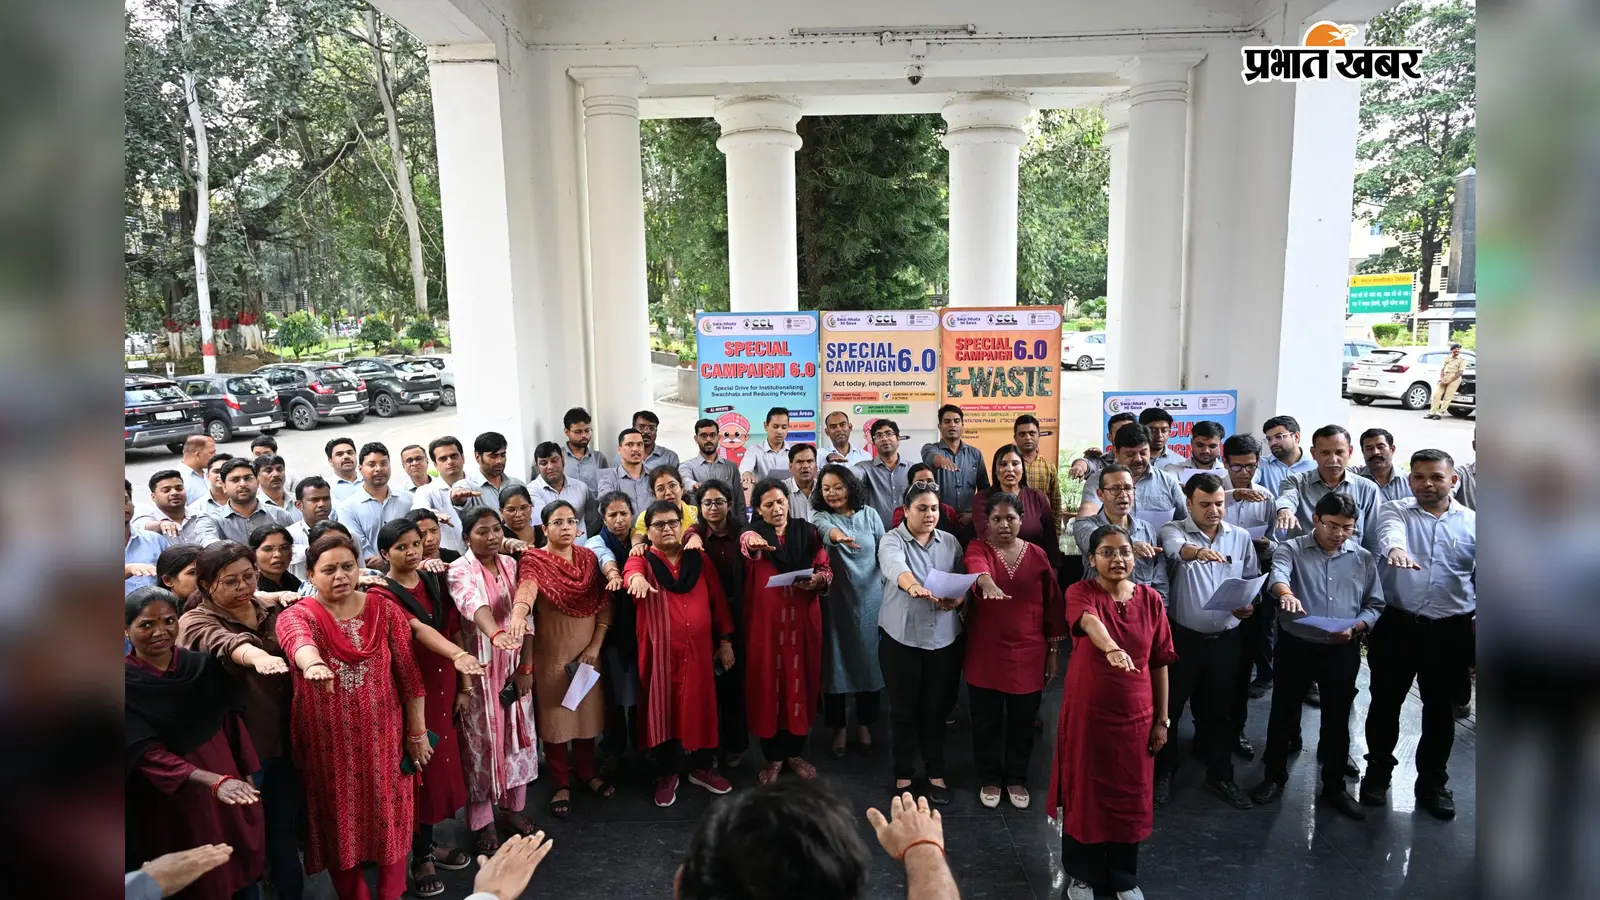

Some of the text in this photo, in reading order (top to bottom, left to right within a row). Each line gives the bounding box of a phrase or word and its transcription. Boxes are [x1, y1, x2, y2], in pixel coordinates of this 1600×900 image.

[752, 319, 774, 327] CCL
[996, 314, 1017, 322] CCL
[724, 341, 792, 357] SPECIAL
[826, 342, 896, 359] SPECIAL
[955, 338, 1012, 350] SPECIAL
[955, 340, 1047, 361] CAMPAIGN 6.0
[826, 348, 936, 373] CAMPAIGN 6.0
[700, 362, 816, 379] CAMPAIGN 6.0
[946, 366, 1052, 398] E-WASTE
[1164, 398, 1187, 406] CCL
